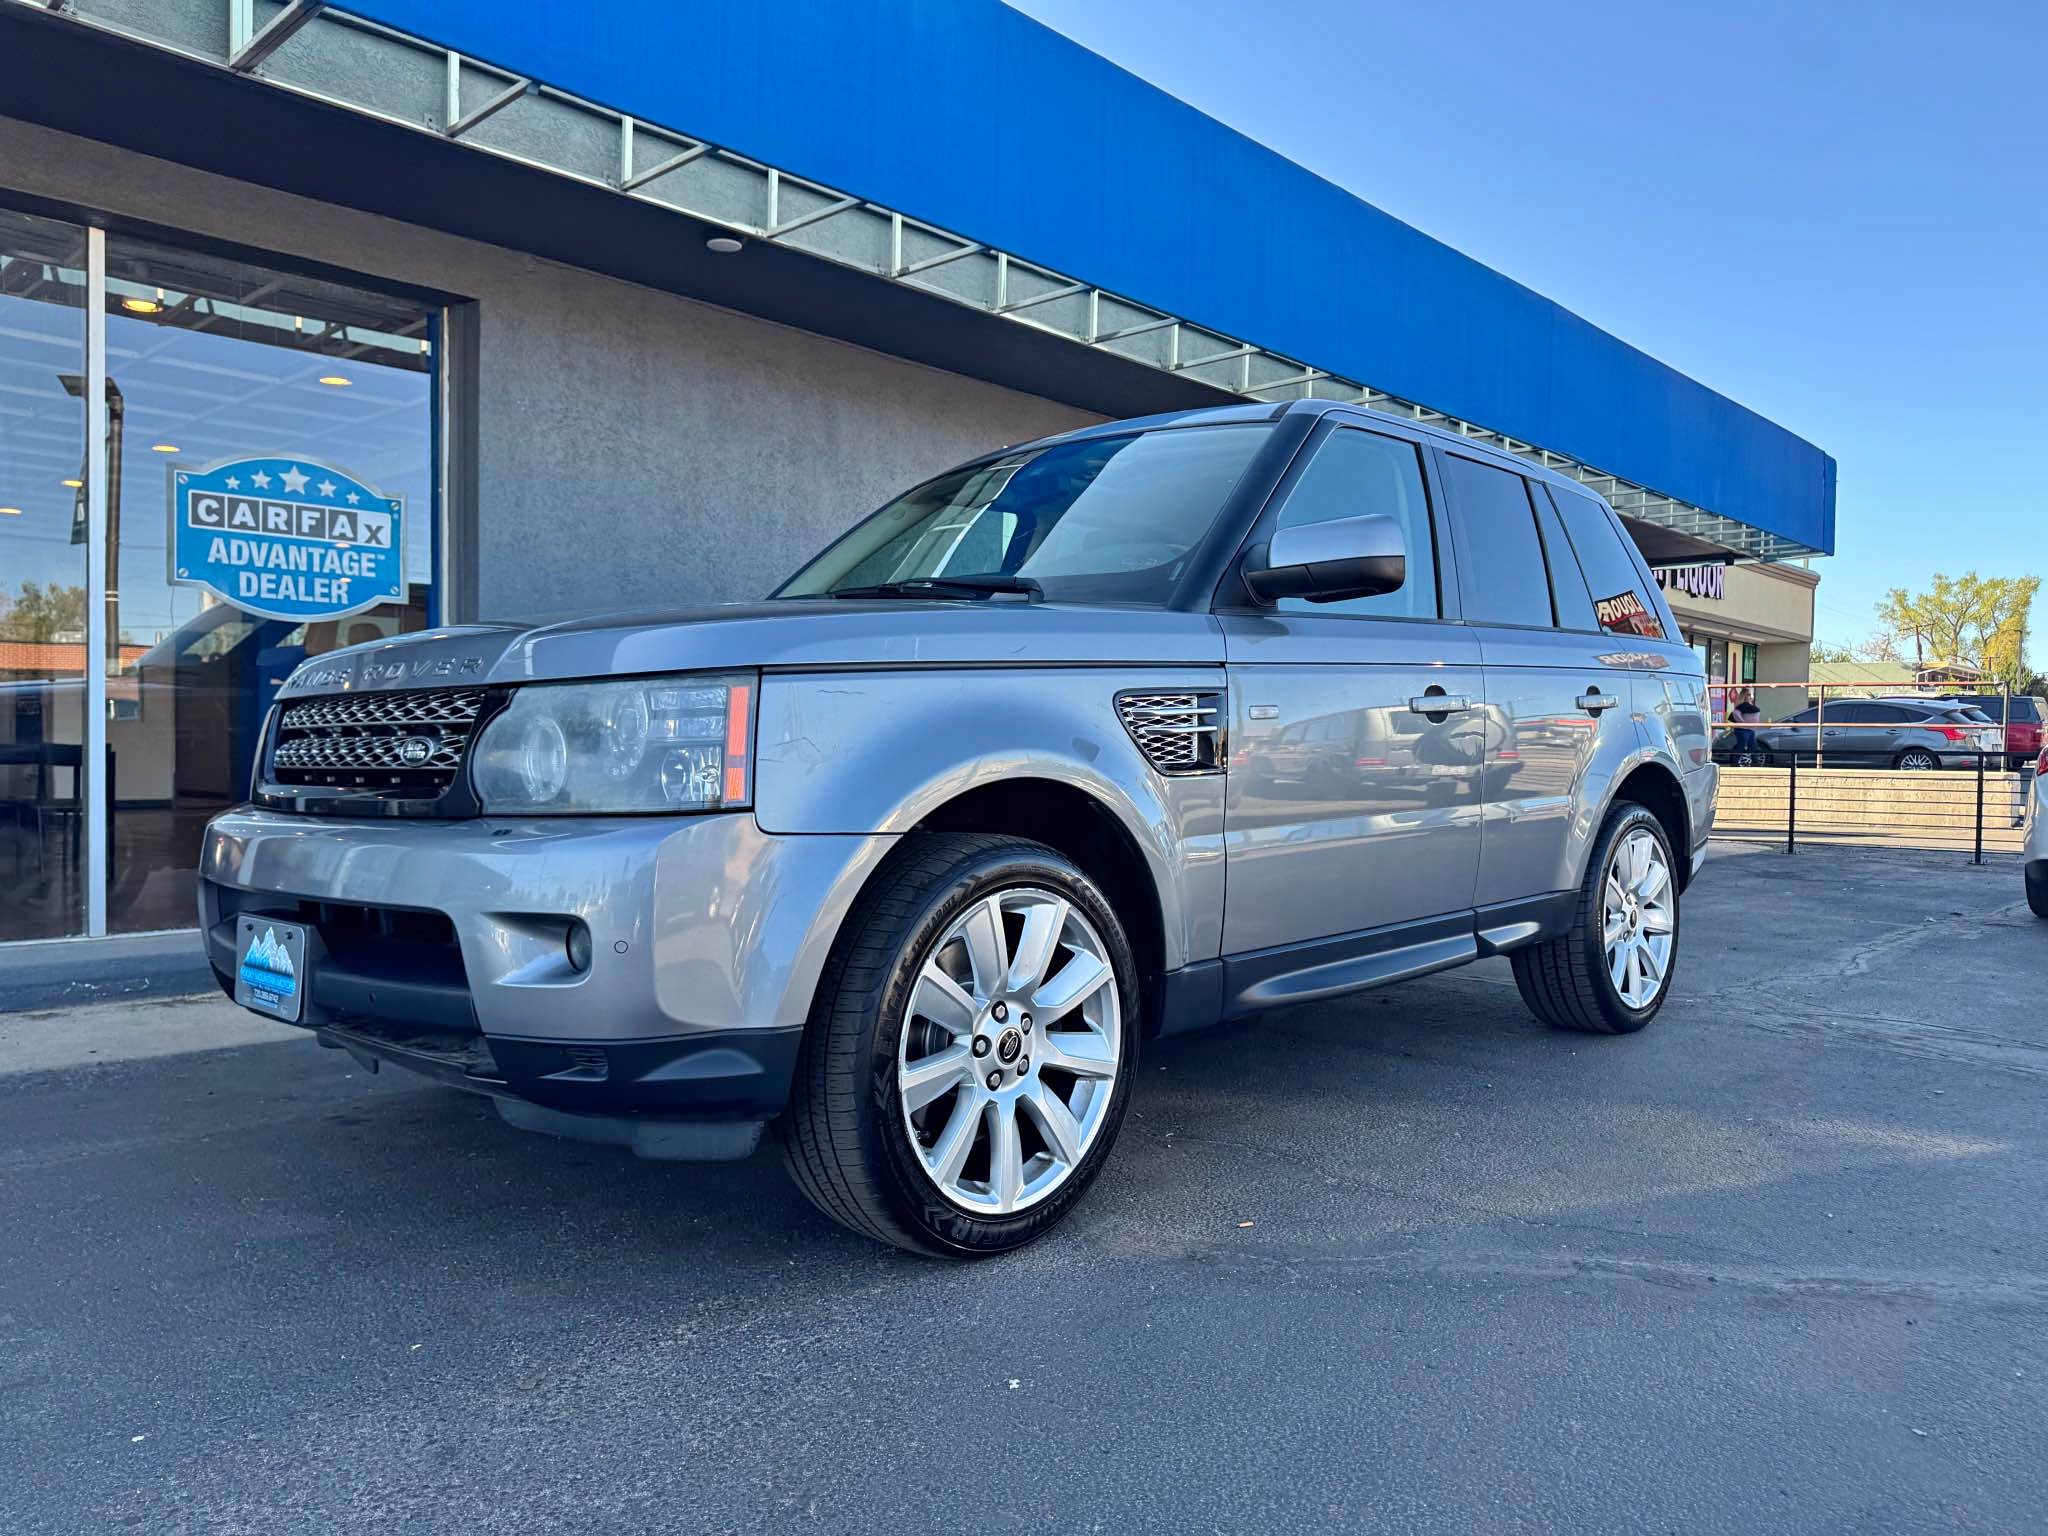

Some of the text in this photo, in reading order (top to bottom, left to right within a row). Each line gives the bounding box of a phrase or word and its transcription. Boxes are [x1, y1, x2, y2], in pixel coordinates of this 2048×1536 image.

[196, 497, 385, 546] CARFAX
[239, 571, 349, 605] DEALER
[1677, 565, 1725, 600] LIQUOR
[364, 656, 485, 681] ROVER
